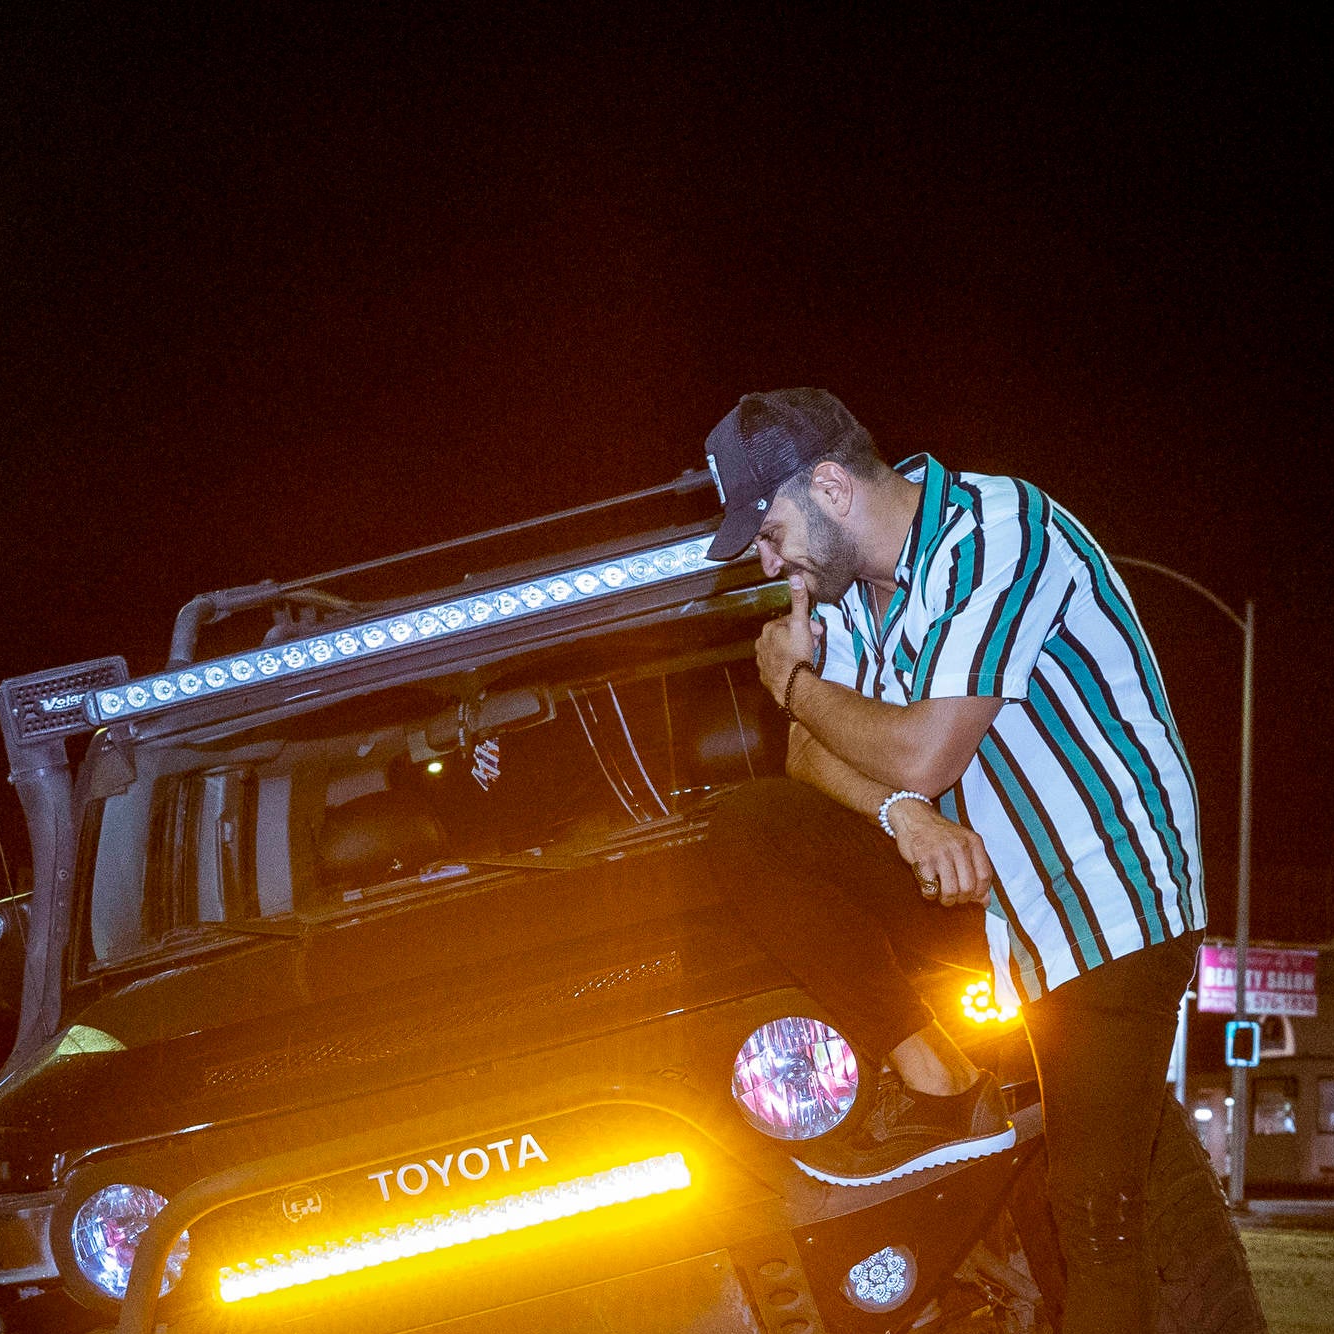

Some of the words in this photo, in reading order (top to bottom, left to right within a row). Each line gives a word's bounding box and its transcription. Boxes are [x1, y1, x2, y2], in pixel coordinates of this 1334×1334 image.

[1205, 966, 1263, 989] BEATY
[1267, 971, 1315, 990] SALON
[368, 1133, 549, 1202] TOYOTA
